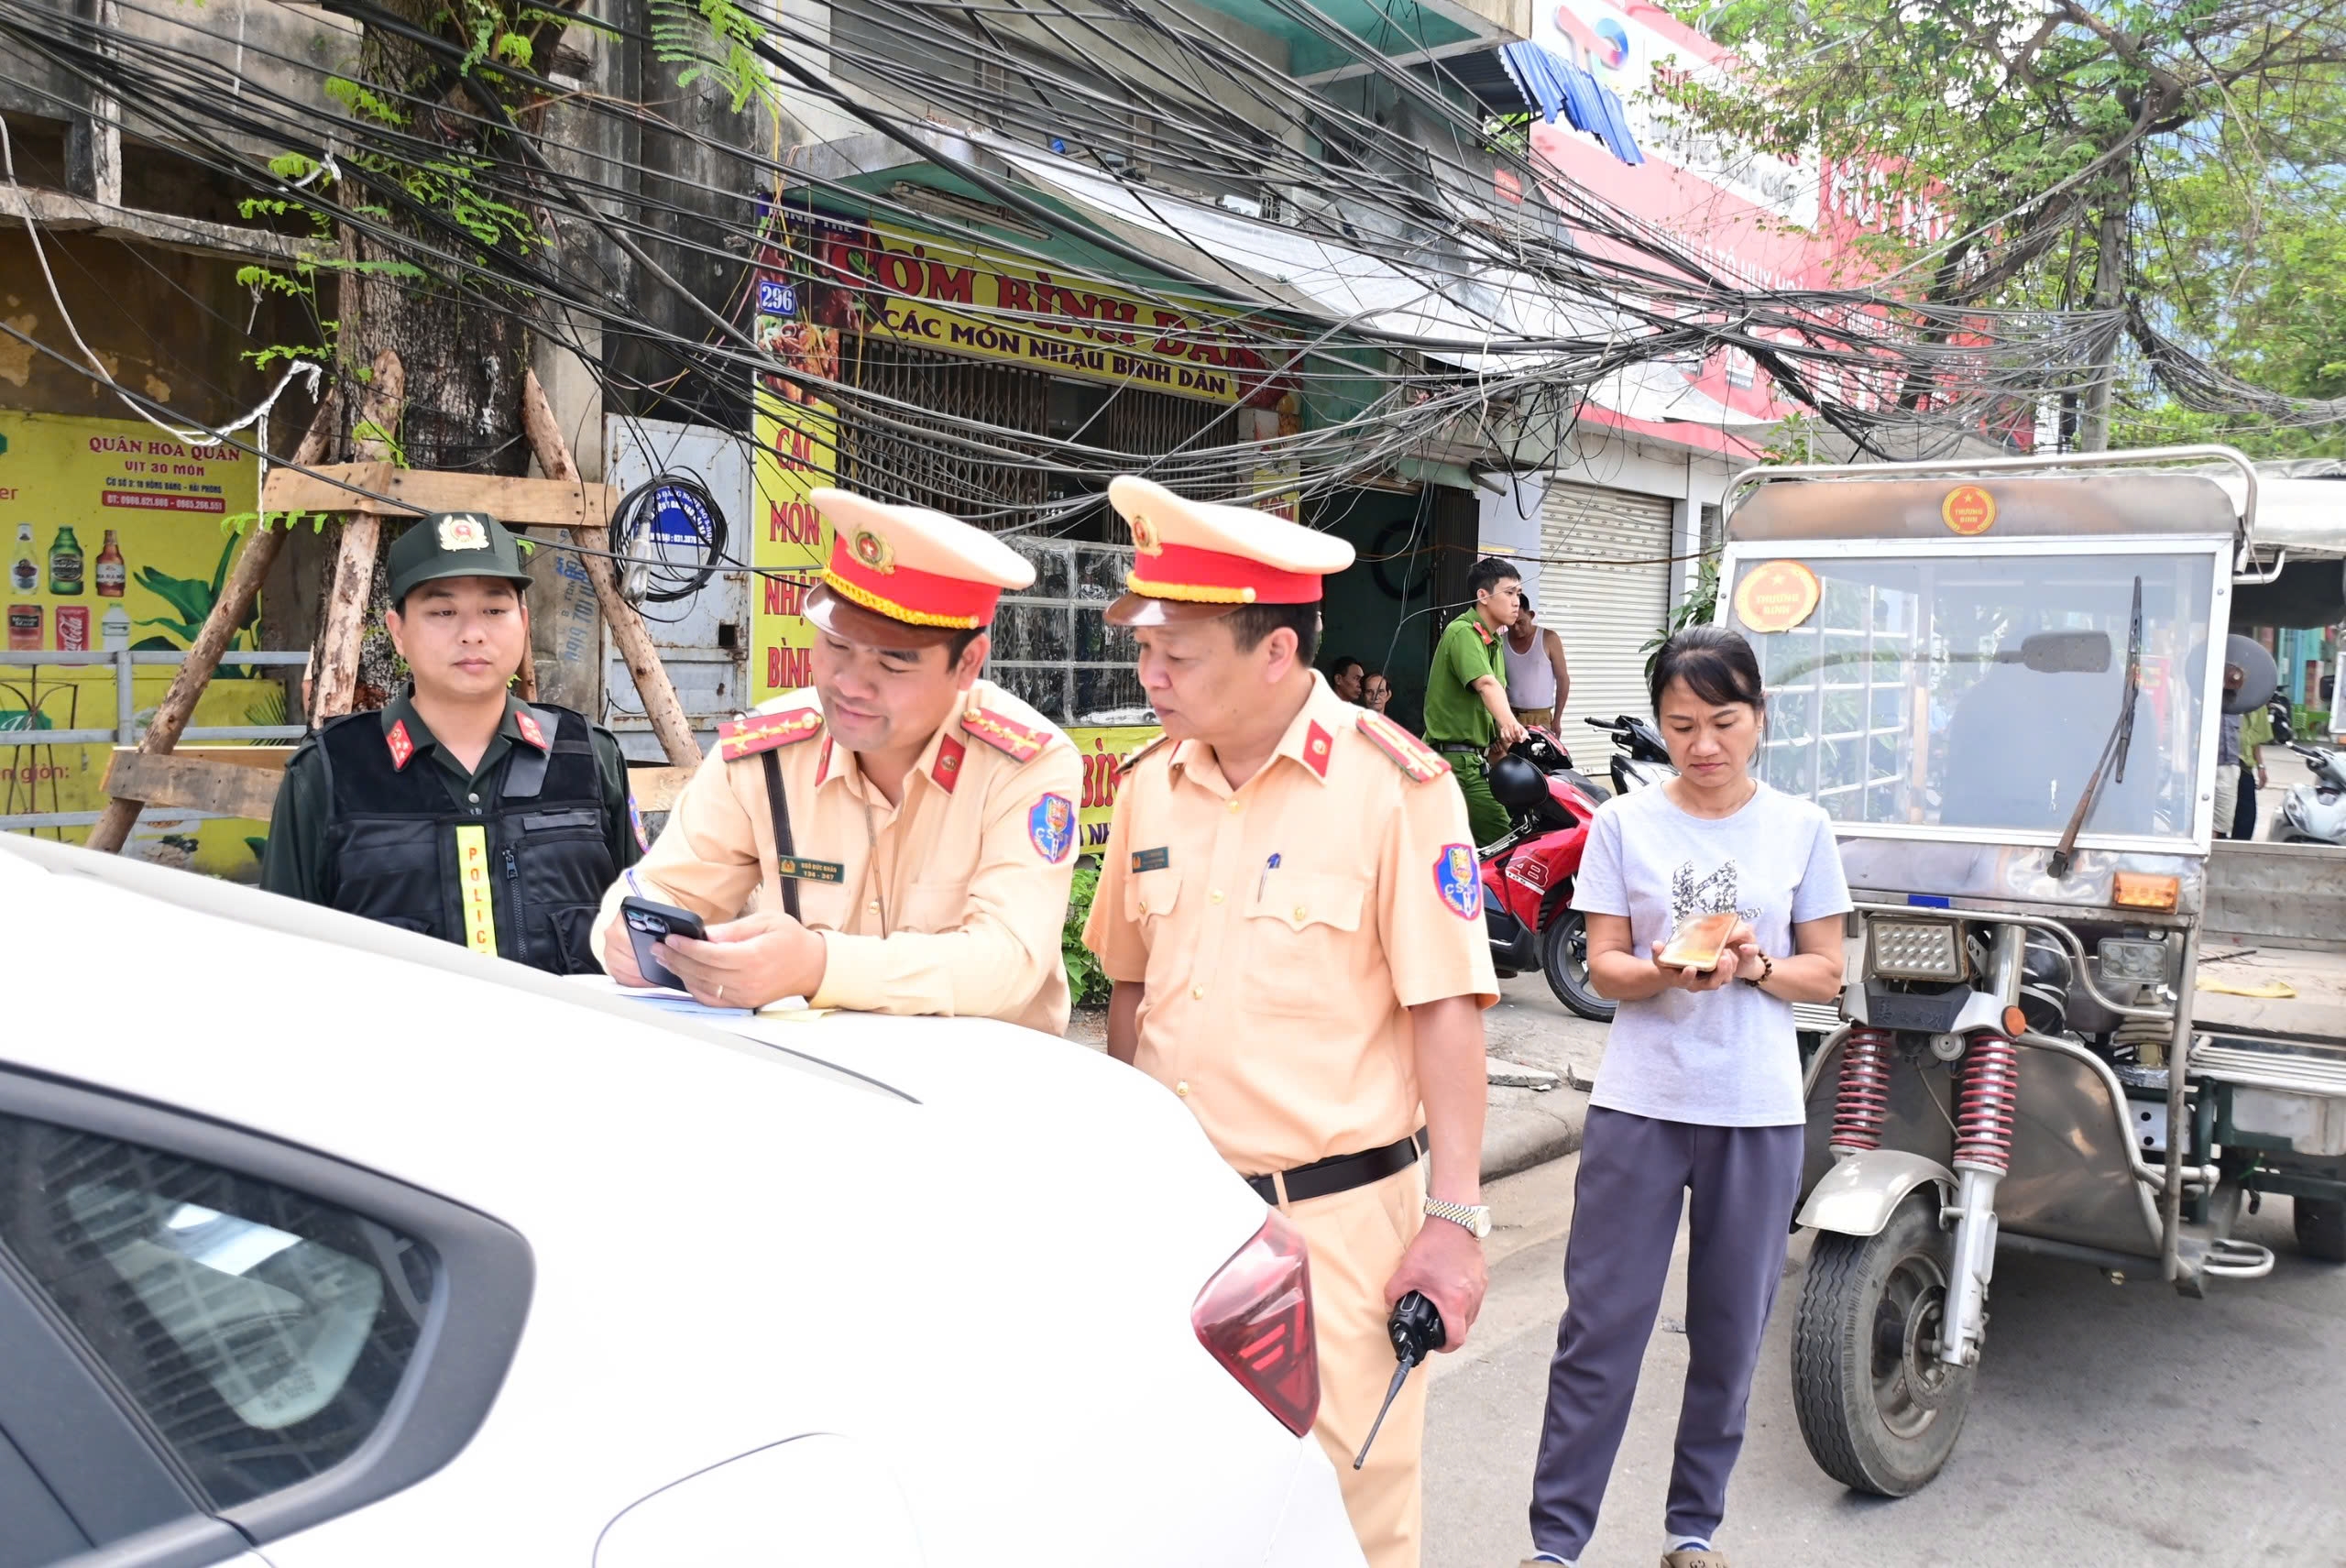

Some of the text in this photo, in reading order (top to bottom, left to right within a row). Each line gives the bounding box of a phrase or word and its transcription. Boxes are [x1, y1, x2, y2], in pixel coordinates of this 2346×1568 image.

[762, 285, 793, 312] 296
[830, 238, 976, 310] CƠM
[996, 270, 1137, 346] BÌNH
[880, 310, 941, 338] CÁC
[949, 322, 1021, 356] MÓN
[1028, 338, 1104, 370] NHẬU
[1178, 368, 1225, 395] DÂN
[89, 435, 143, 454] QUÂN
[148, 442, 186, 457] HOA
[150, 463, 169, 474] 30
[173, 464, 205, 477] MÓN
[776, 419, 817, 473] CÁC
[770, 493, 820, 546] MÓN
[764, 568, 823, 626] NHẬ
[1080, 737, 1129, 807] BÌN
[469, 847, 487, 953] POLIC
